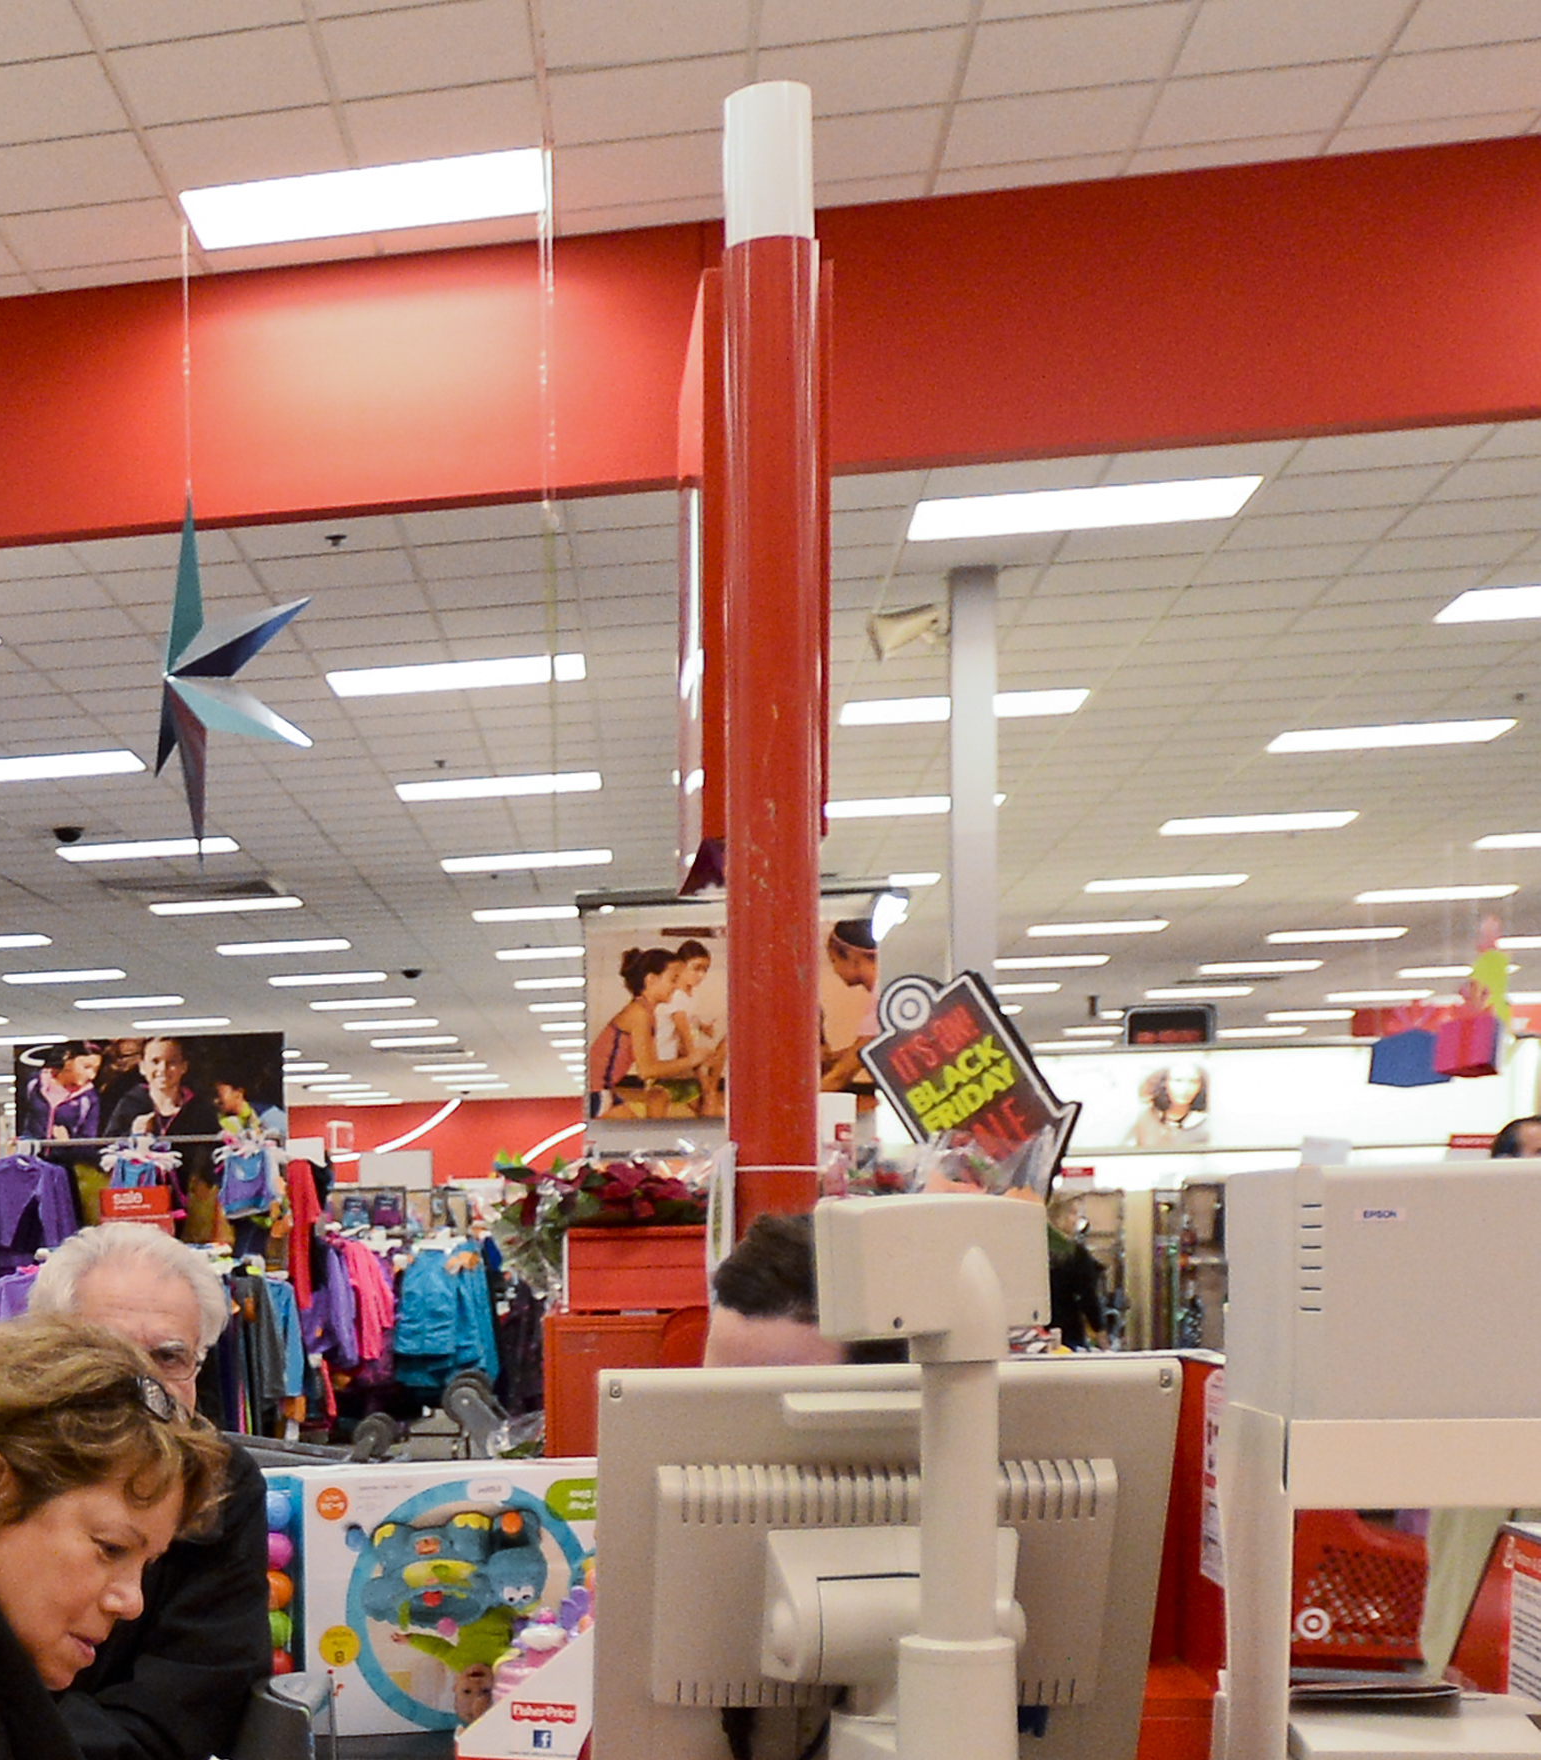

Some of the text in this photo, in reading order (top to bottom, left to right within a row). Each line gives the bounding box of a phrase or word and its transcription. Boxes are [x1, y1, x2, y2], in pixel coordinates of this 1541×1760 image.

[889, 1034, 942, 1084] IT'S
[905, 1034, 1006, 1114] BLACK
[920, 1057, 1016, 1133] FRIDAY
[112, 1190, 143, 1205] sale
[1362, 1209, 1398, 1219] EPSON
[512, 1703, 576, 1719] Fisher-Price
